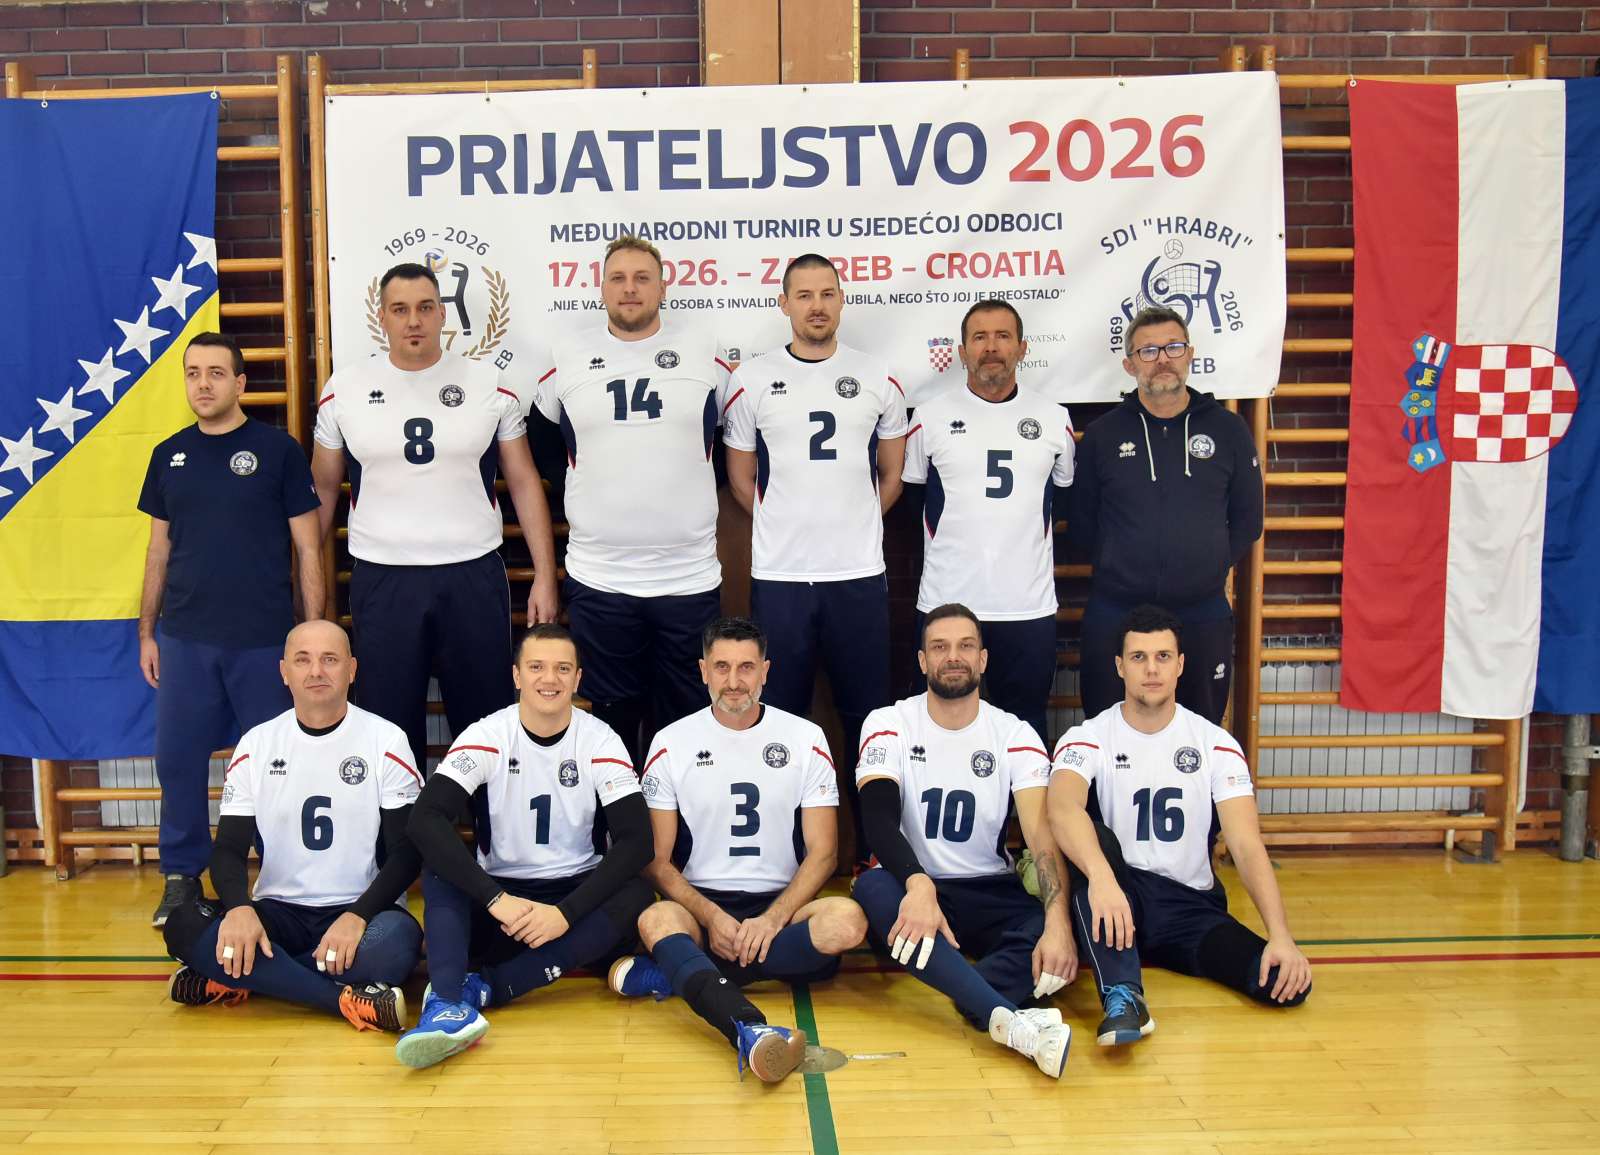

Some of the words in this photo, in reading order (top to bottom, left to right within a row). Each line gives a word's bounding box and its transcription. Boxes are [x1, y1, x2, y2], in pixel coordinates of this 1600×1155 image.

[407, 121, 988, 197] PRIJATELJSTVO
[1008, 114, 1206, 183] 2026
[384, 228, 426, 257] 1969
[444, 227, 490, 256] 2026
[550, 220, 727, 243] MEĐUNARODNI
[733, 218, 821, 239] TURNIR
[827, 218, 843, 237] U
[850, 211, 960, 237] SJEDEĆOJ
[967, 212, 1063, 233] ODBOJCI
[1100, 224, 1137, 255] SDI
[1143, 216, 1253, 249] "HRABRI"
[760, 256, 893, 285] ZREB
[926, 249, 1066, 280] CROATIA
[670, 298, 714, 310] OSOBA
[717, 298, 725, 309] S
[889, 292, 923, 304] NEGO
[925, 290, 950, 304] ŠTO
[953, 291, 971, 303] JOJ
[974, 291, 986, 302] JE
[1220, 290, 1244, 332] 2026
[1023, 333, 1067, 344] RVATSKA
[1110, 316, 1123, 354] 1969
[606, 377, 663, 421] 14
[403, 417, 435, 465] 8
[808, 410, 838, 461] 2
[985, 449, 1014, 499] 5
[301, 795, 334, 851] 6
[530, 794, 552, 844] 1
[730, 782, 761, 837] 3
[921, 787, 976, 843] 10
[1133, 787, 1185, 842] 16
